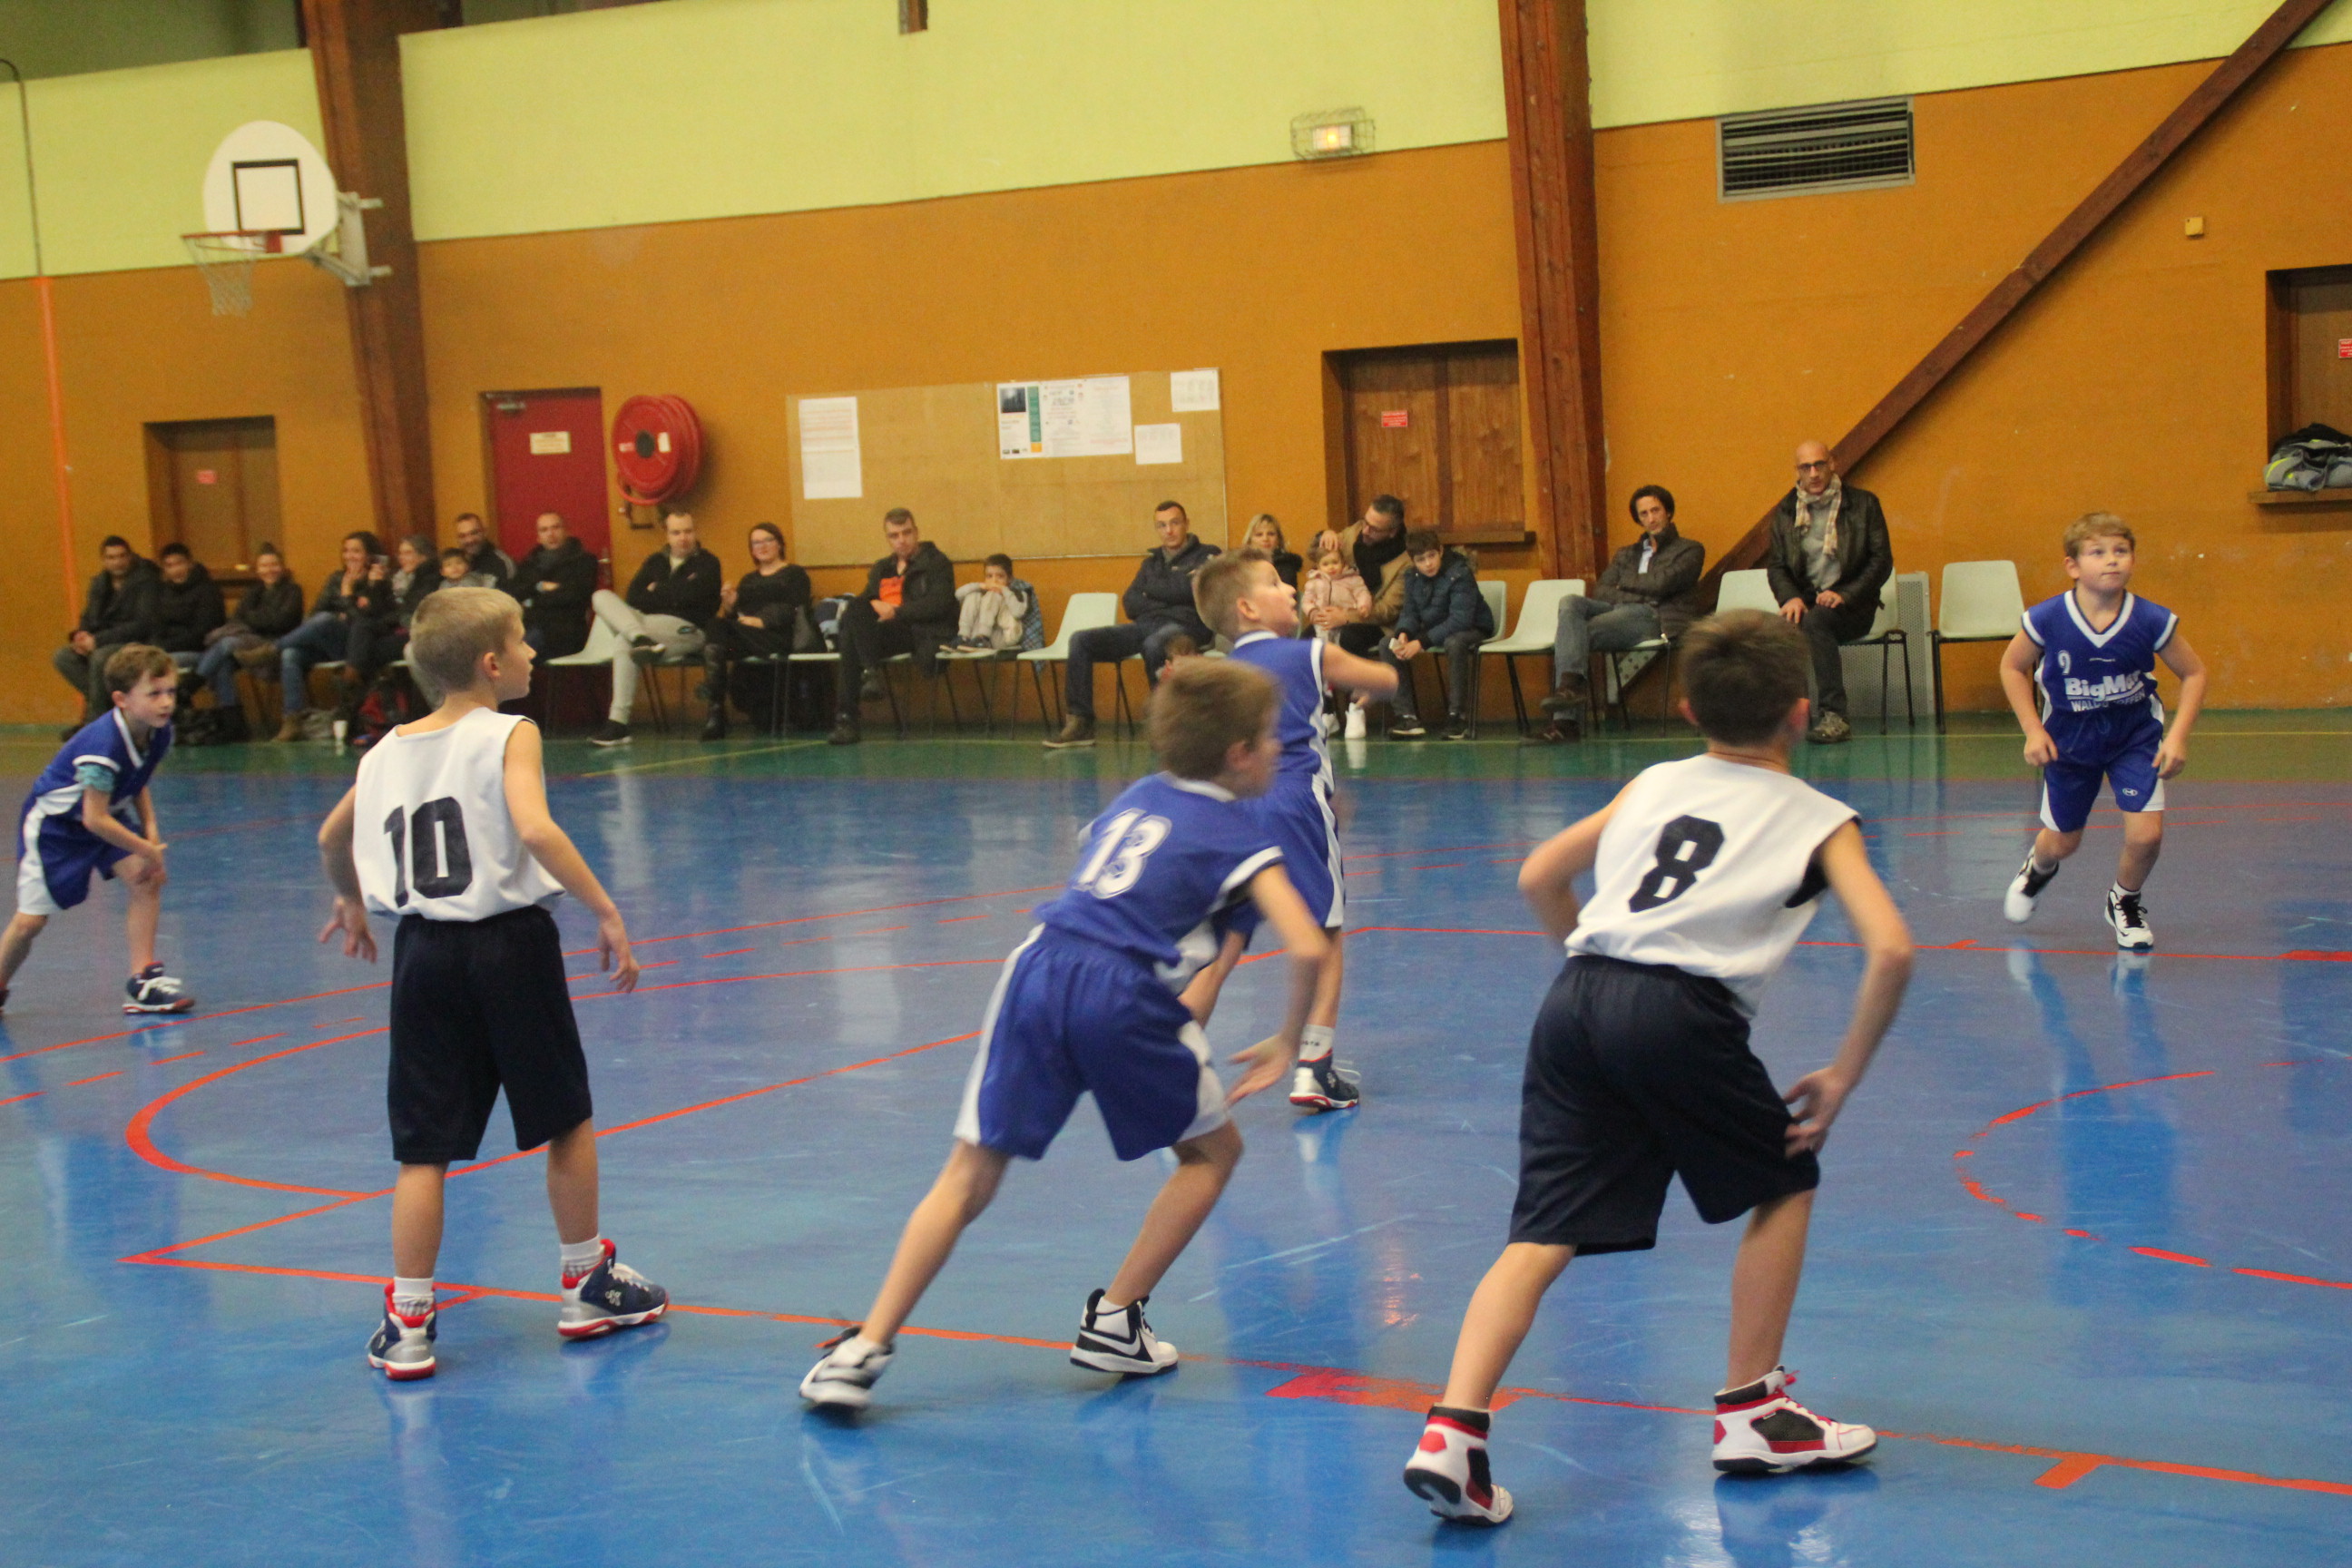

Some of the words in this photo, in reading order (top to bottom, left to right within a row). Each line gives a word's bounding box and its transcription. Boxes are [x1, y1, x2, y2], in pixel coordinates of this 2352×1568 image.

[2057, 650, 2071, 676] 9
[384, 796, 473, 908] 10
[1073, 808, 1172, 899] 13
[1628, 815, 1725, 913] 8
